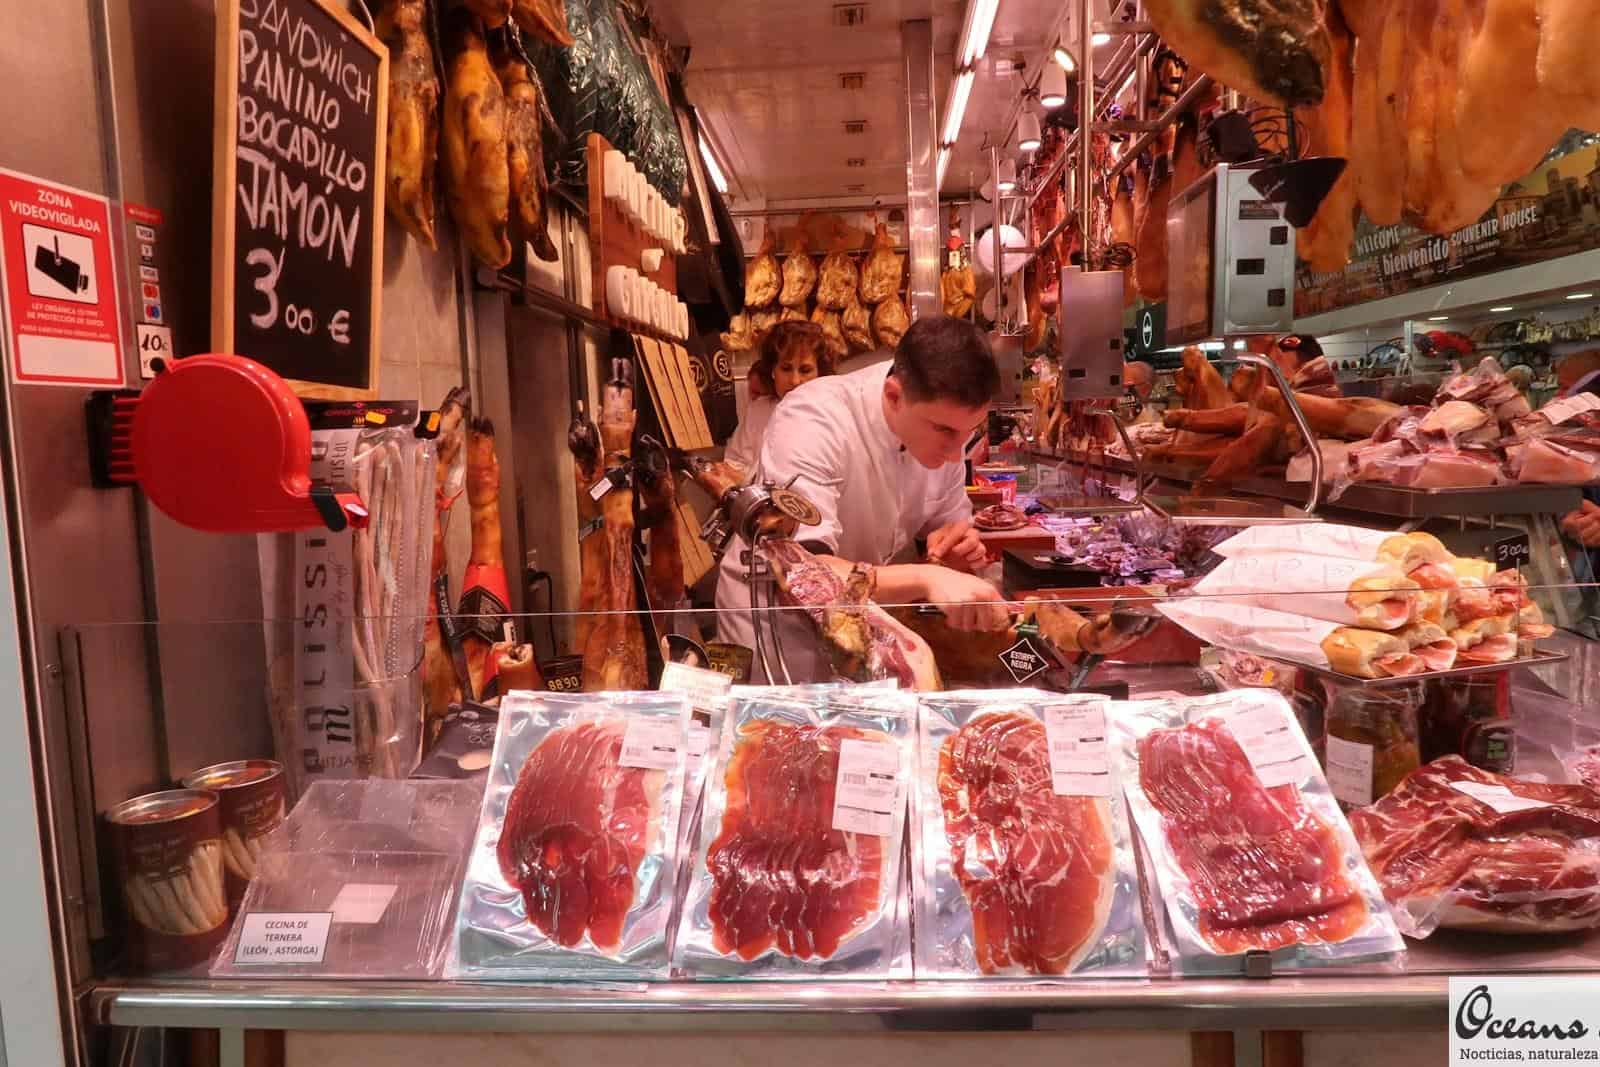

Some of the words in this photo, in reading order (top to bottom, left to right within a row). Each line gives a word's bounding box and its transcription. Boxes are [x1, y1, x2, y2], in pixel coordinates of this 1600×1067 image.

[240, 29, 340, 130] PANINO
[238, 97, 366, 192] BOCADILLO
[9, 200, 101, 233] VIDEOVIGILADA
[37, 190, 73, 209] ZONA
[237, 145, 360, 268] JAMÓN
[1451, 218, 1498, 248] SOUVENIR
[1502, 206, 1537, 232] HOUSE
[1382, 237, 1449, 277] bienvenido
[1011, 659, 1033, 671] NEGRA
[265, 921, 295, 929] CECINA
[297, 921, 308, 929] DE
[265, 933, 302, 942] TERNERA
